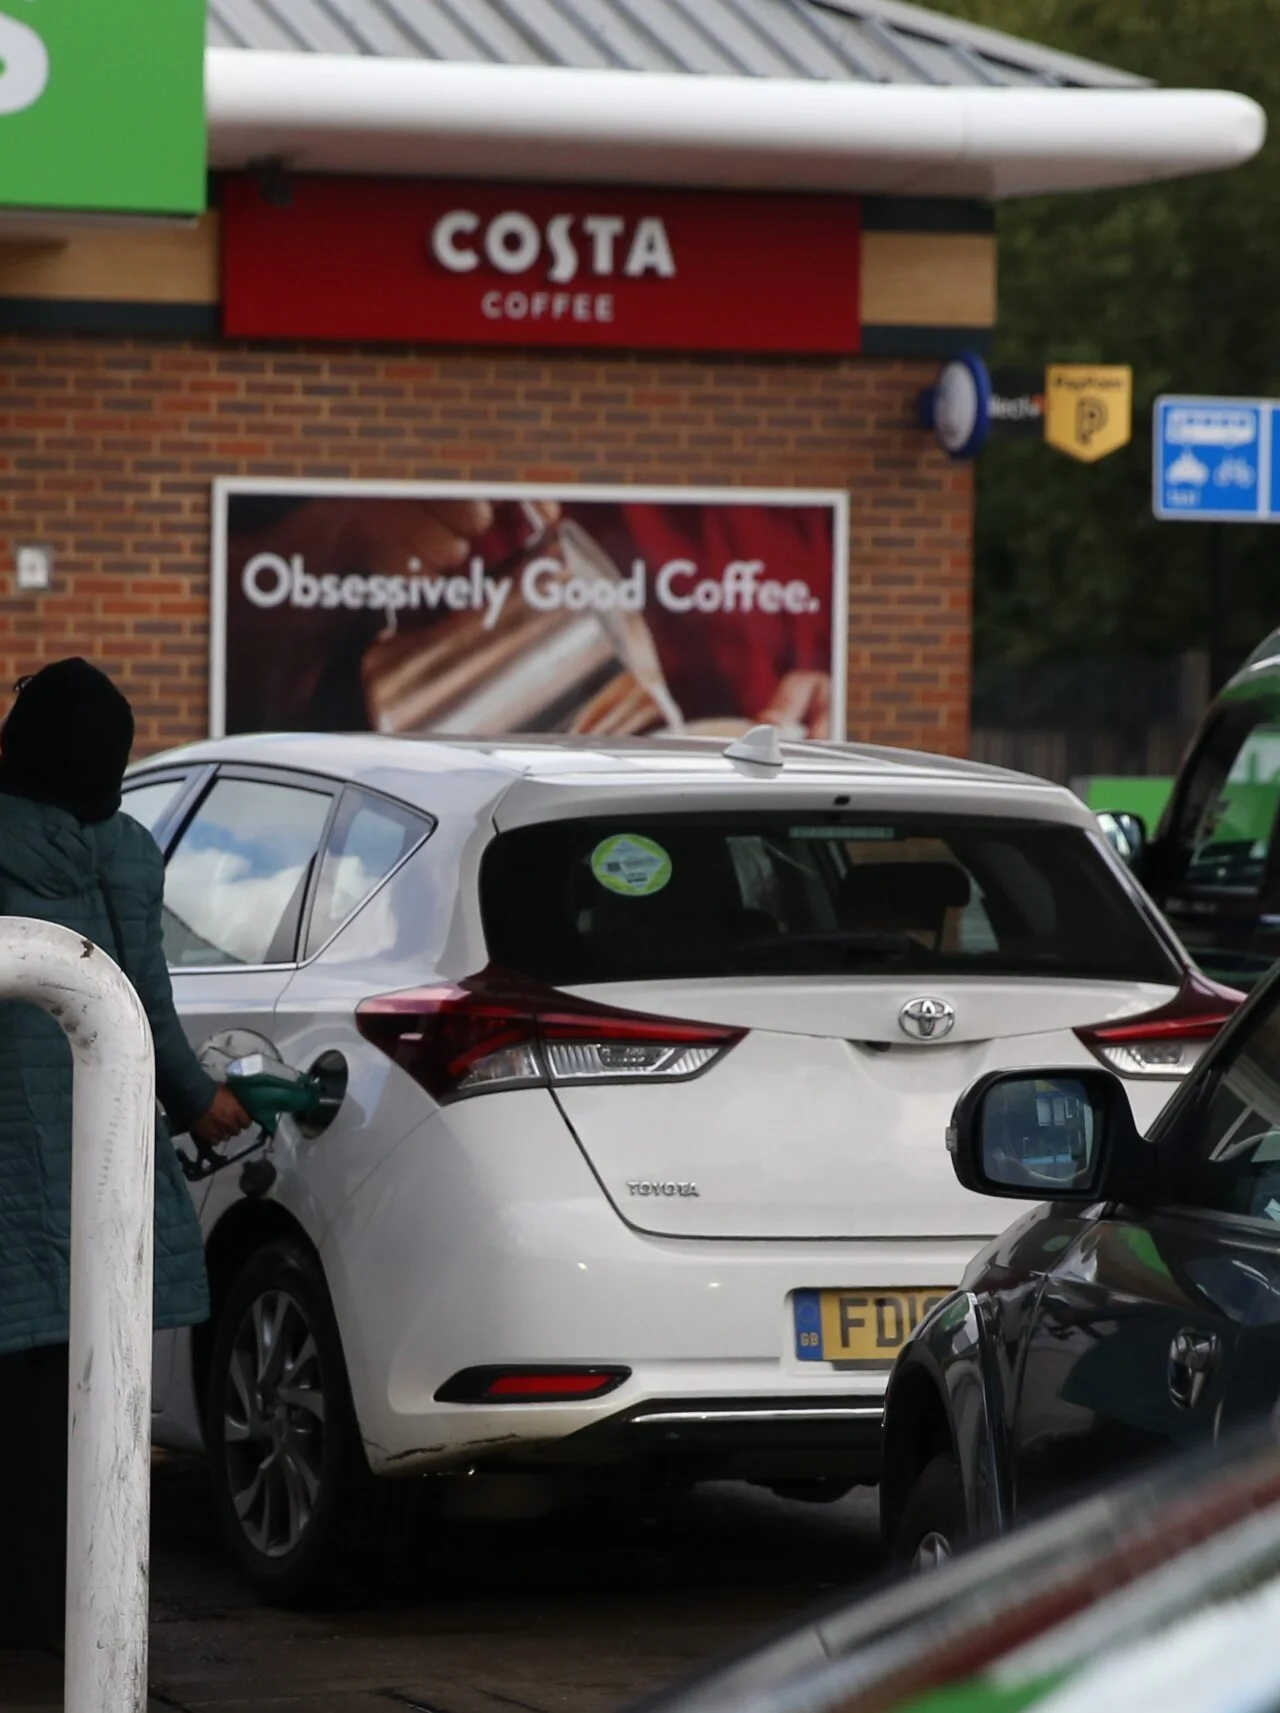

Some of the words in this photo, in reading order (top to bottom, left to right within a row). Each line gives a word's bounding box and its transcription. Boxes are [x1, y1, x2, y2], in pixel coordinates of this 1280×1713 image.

[431, 209, 677, 283] COSTA
[481, 290, 614, 322] COFFEE
[242, 552, 512, 639] Obsessively
[521, 557, 646, 613] Good
[655, 558, 819, 613] Coffee.
[625, 1180, 701, 1198] TOYOTA
[800, 1332, 819, 1347] GB
